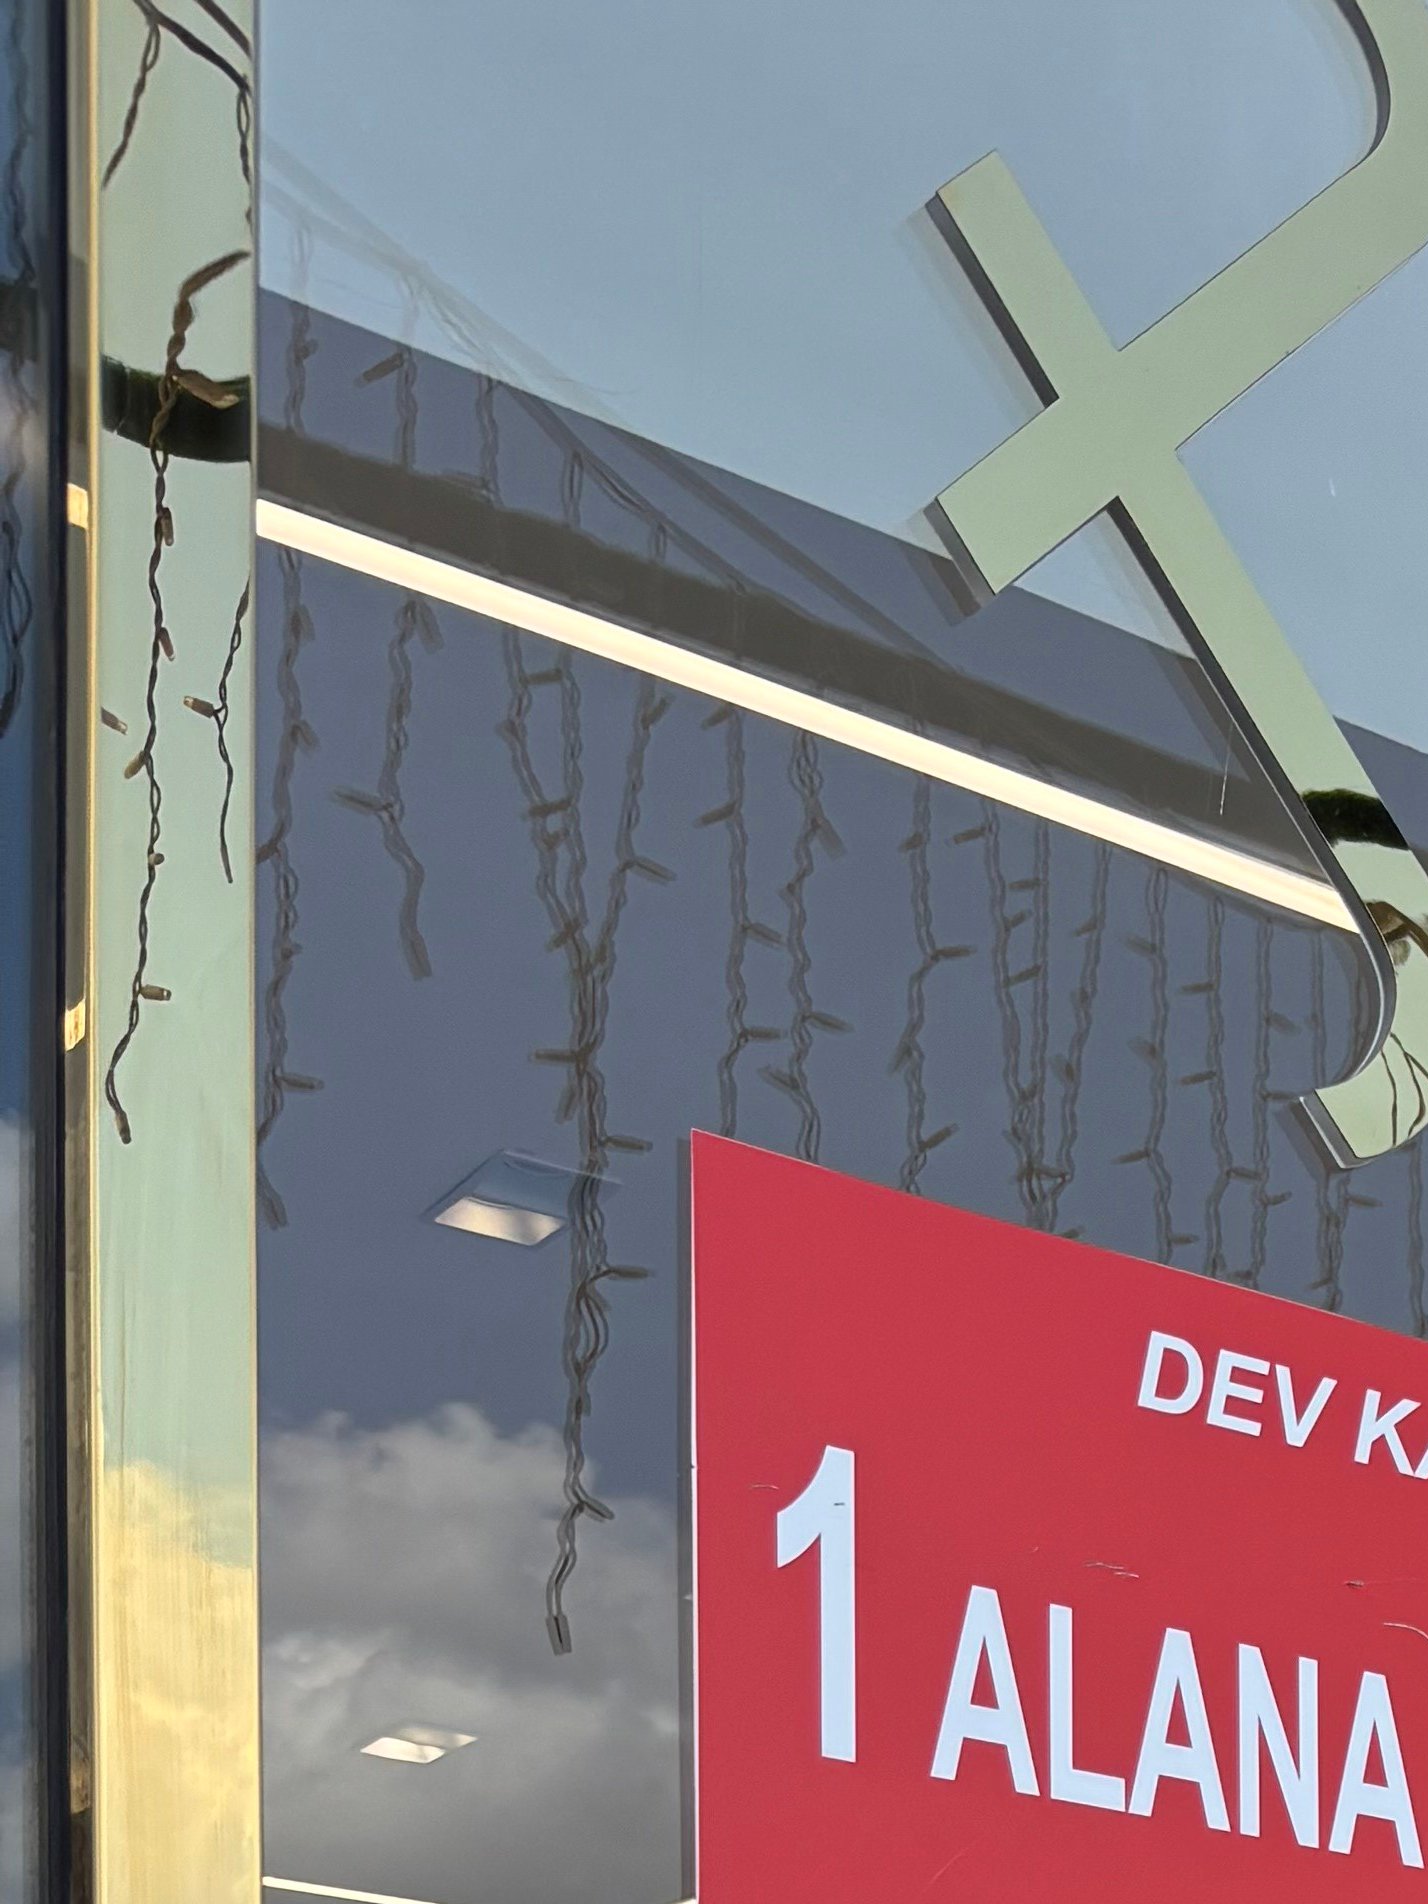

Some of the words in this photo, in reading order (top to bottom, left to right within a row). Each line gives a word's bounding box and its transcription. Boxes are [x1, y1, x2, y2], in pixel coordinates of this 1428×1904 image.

[1137, 1330, 1338, 1448] DEV
[776, 1444, 857, 1764] 1
[930, 1584, 1426, 1870] ALANA
